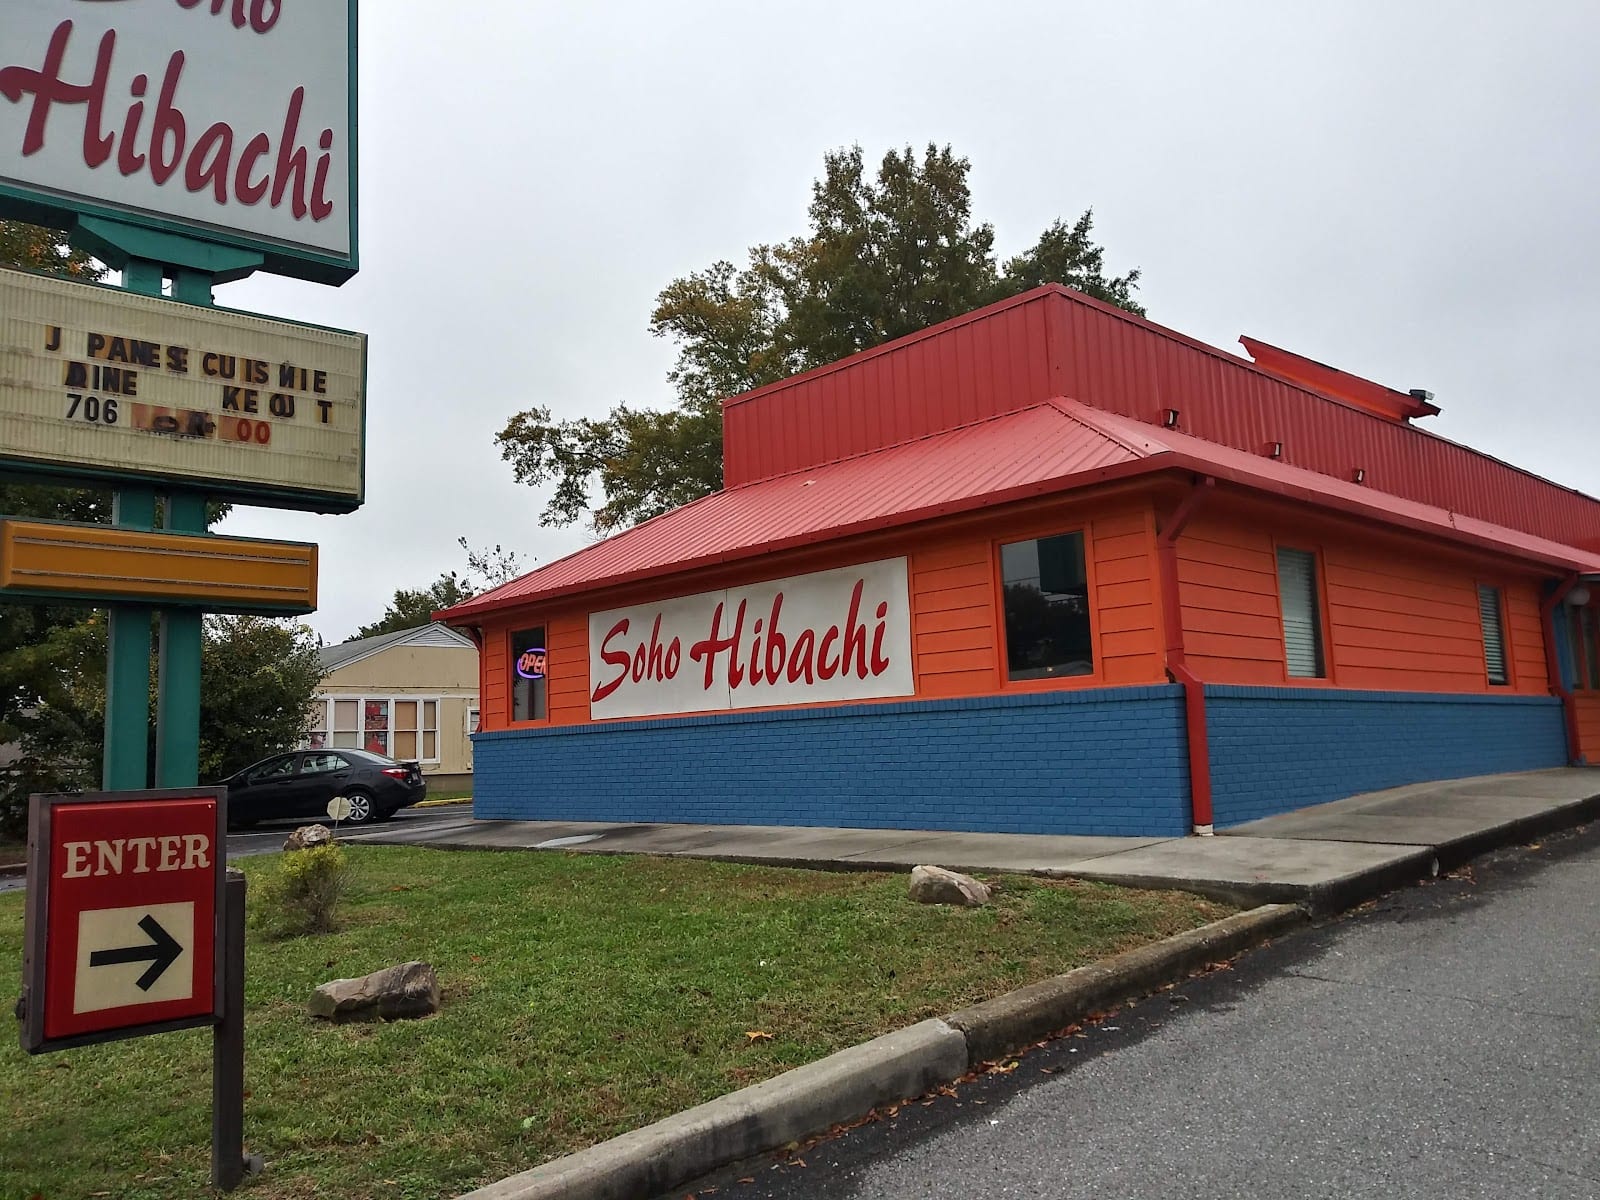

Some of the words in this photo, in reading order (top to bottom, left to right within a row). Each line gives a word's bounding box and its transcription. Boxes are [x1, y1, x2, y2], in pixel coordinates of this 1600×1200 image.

[0, 19, 333, 222] Hibachi
[65, 361, 138, 396] DINE
[223, 386, 258, 413] KE
[66, 394, 118, 424] 706
[592, 612, 681, 703] Soho
[690, 579, 890, 690] Hibachi
[62, 833, 211, 878] ENTER
